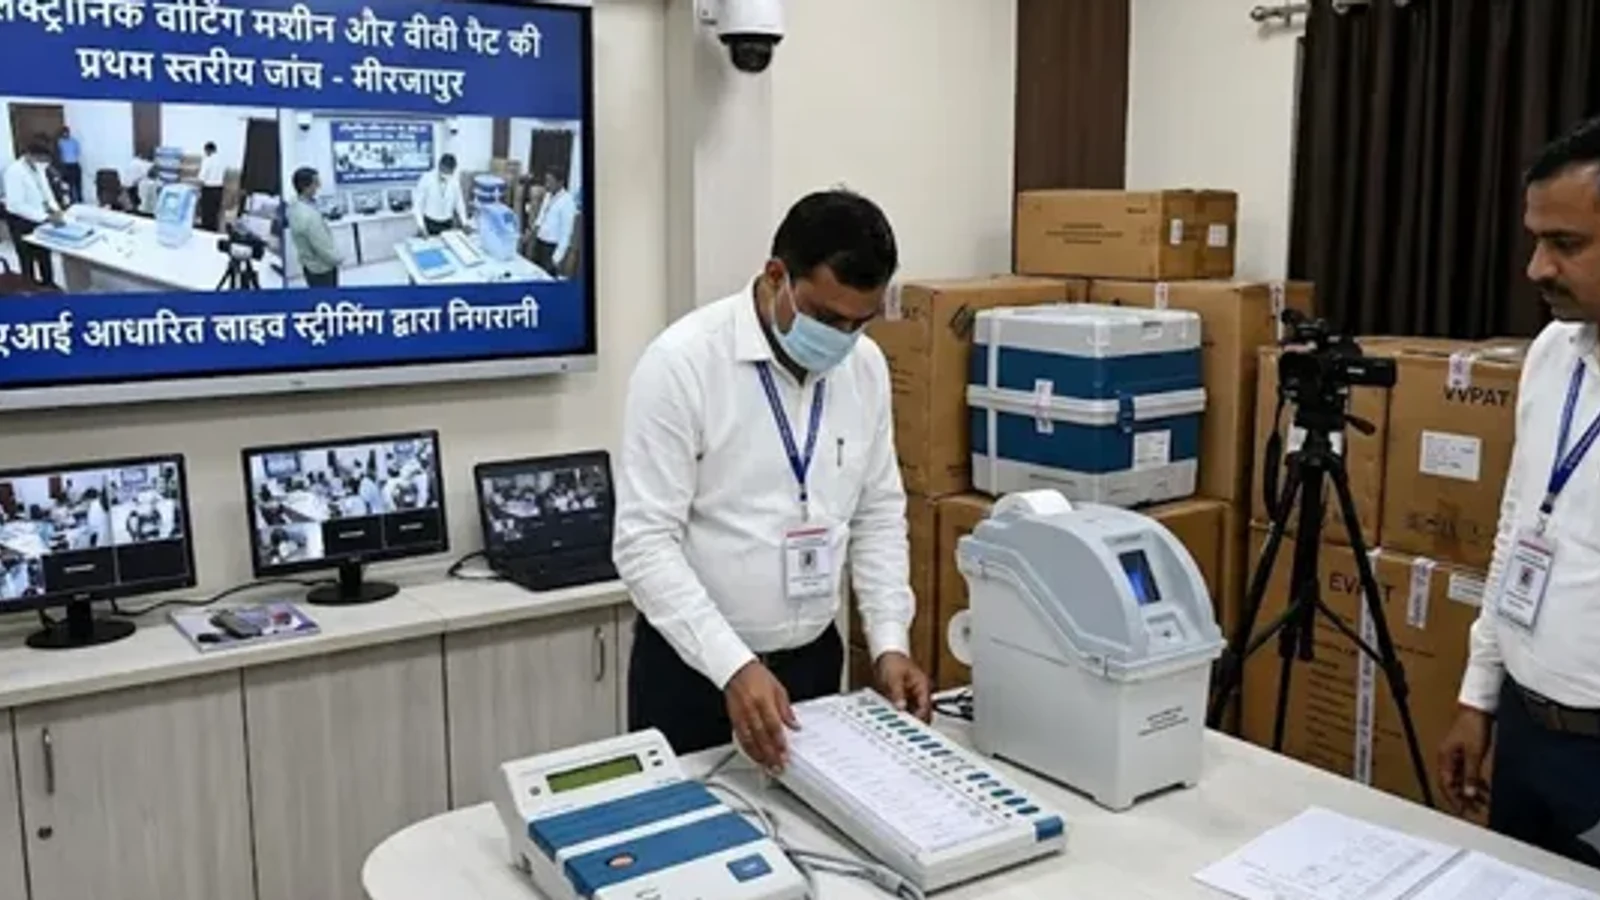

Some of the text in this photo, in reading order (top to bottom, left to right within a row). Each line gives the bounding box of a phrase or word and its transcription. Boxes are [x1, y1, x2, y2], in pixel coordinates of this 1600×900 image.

[252, 3, 336, 43] मशीन
[345, 7, 397, 47] और
[403, 13, 458, 51] वीवी
[465, 15, 501, 55] पैट
[508, 22, 541, 57] की
[76, 47, 466, 103] प्रथम स्तरीय जांच - मीरजापुर
[83, 308, 205, 347] आधारित
[211, 312, 287, 345] लाइव
[293, 301, 384, 345] स्ट्रीमिंग
[389, 307, 442, 337] द्वारा
[449, 296, 539, 331] निगरानी
[1443, 385, 1510, 407] VVPAT
